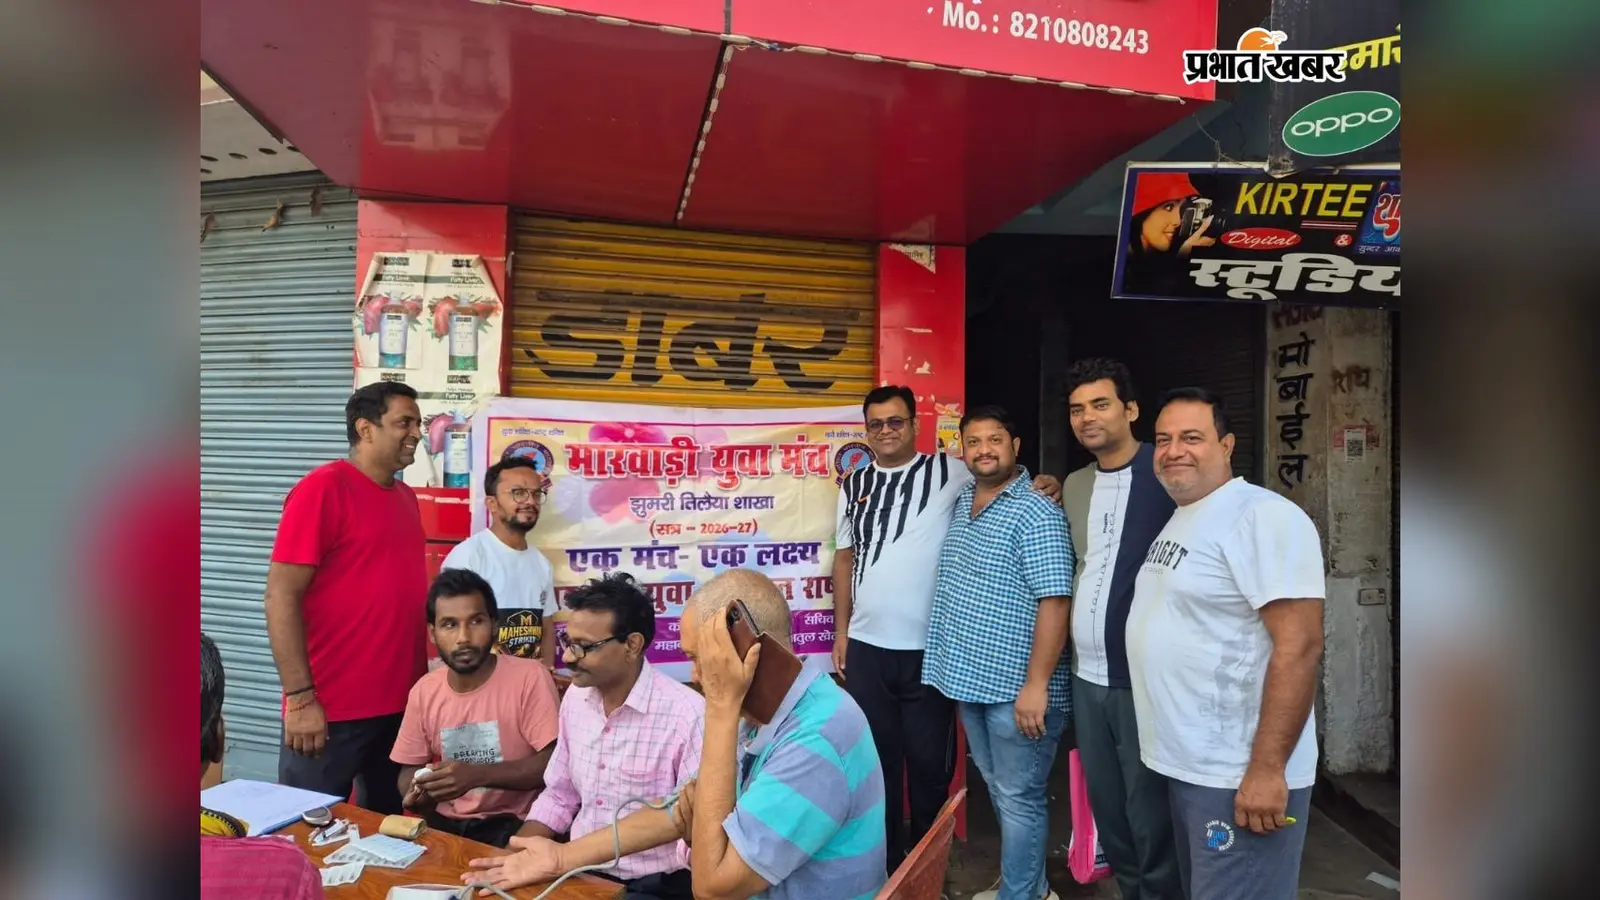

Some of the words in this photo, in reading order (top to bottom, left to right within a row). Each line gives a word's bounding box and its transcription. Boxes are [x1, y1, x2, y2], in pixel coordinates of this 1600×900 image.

[1010, 11, 1149, 54] 8210808243
[1291, 107, 1393, 137] oppo
[1234, 182, 1373, 217] KIRTEE
[1227, 231, 1299, 249] Digital
[563, 435, 701, 487] मारवाड़ी
[710, 445, 772, 489] युवा
[778, 434, 830, 477] मंच
[630, 492, 675, 518] झुमरी
[680, 491, 729, 511] तिलैया
[734, 495, 775, 510] शाखा
[566, 548, 622, 572] एक
[698, 544, 748, 568] एक
[754, 542, 821, 566] लक्ष्य
